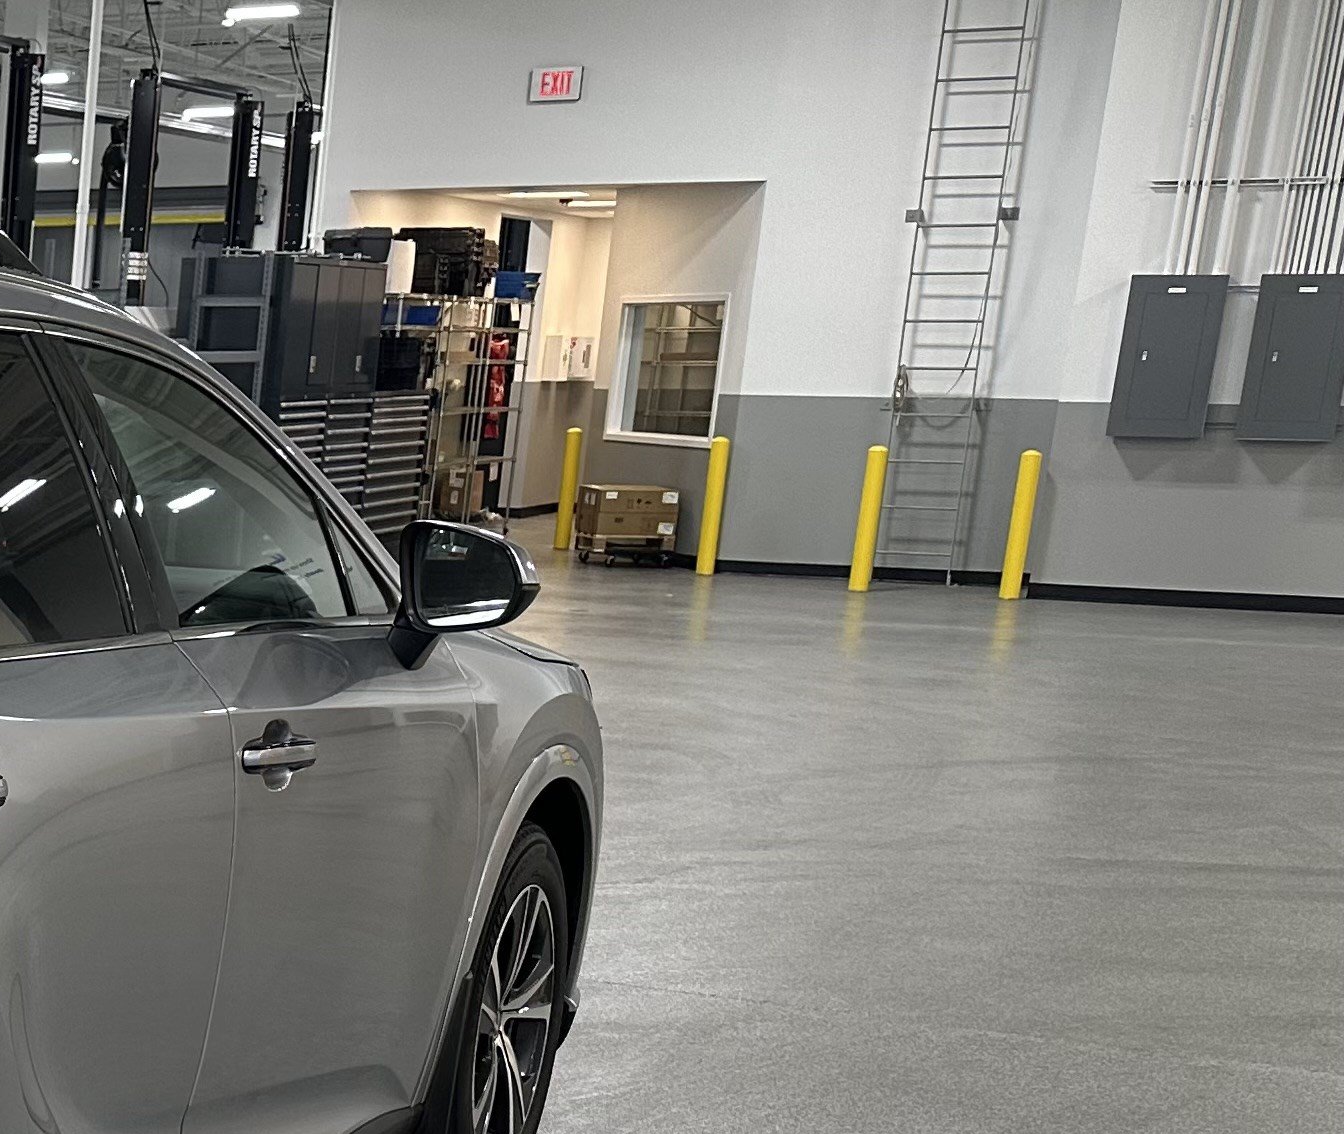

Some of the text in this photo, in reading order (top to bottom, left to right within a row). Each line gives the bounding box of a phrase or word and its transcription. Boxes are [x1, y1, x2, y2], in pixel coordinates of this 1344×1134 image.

[540, 71, 574, 96] EXIT
[27, 86, 40, 145] ROTARY
[248, 127, 260, 178] ROTARY
